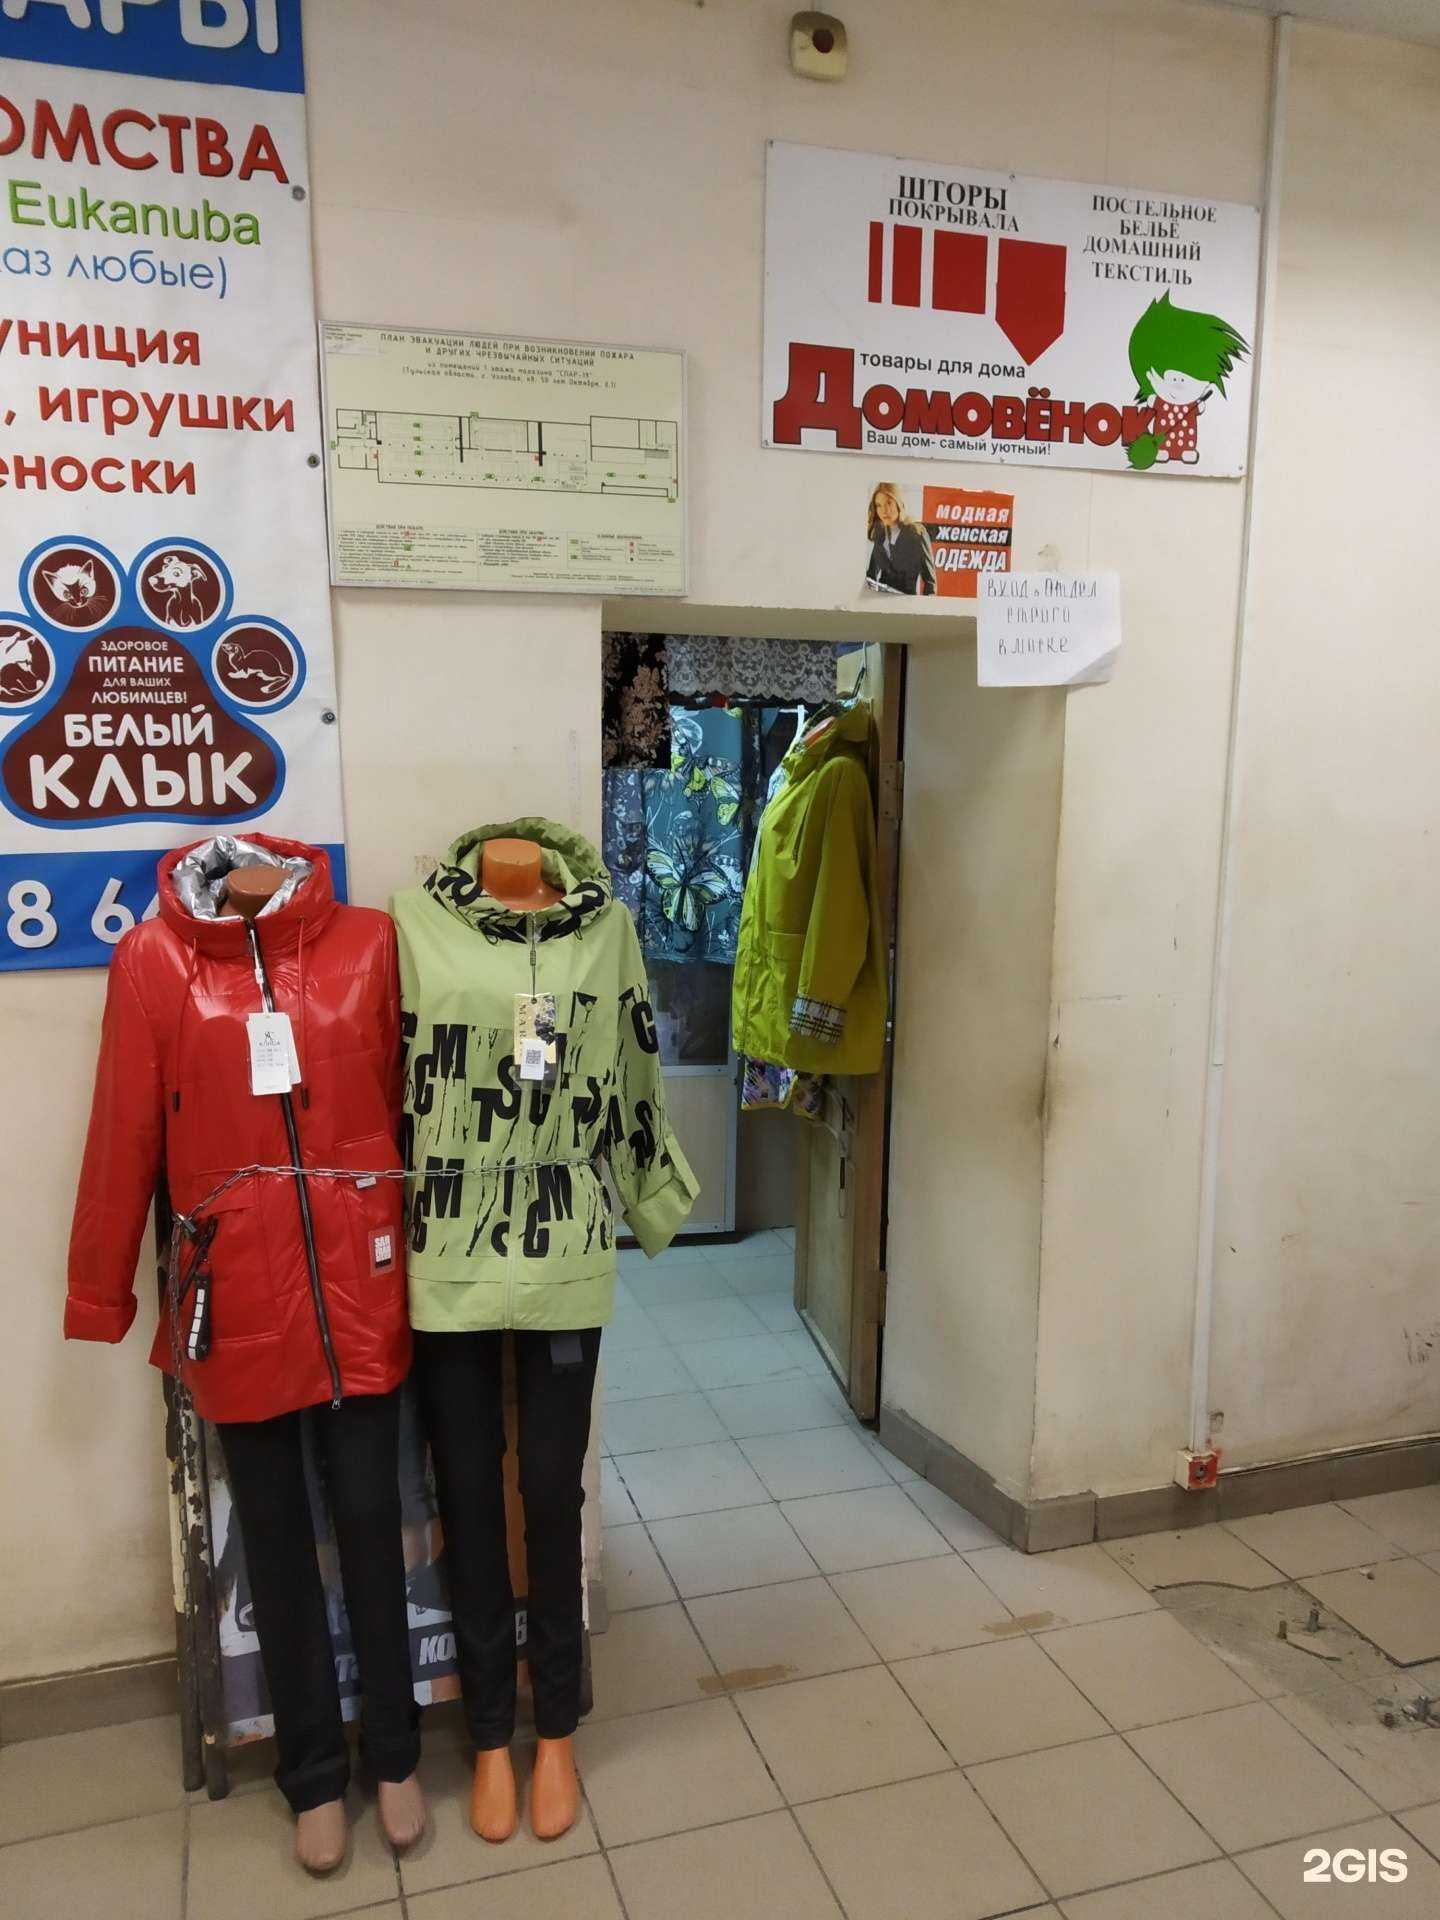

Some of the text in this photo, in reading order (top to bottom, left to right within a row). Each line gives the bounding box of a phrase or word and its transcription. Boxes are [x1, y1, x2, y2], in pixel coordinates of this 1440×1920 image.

[898, 175, 1009, 211] ШТОРЫ
[8, 179, 261, 246] Eukanuba
[889, 198, 1020, 233] ПОКРЫВАЛА
[1092, 194, 1218, 223] ПОСТЕЛЬНОЕ
[1119, 217, 1180, 239] БЕЛЬЁ
[1082, 235, 1201, 261] ДОМАШНИЙ
[0, 246, 228, 299] аз любые)
[1091, 261, 1193, 286] ТЕКСТИЛЬ
[380, 333, 406, 343] ПЛАН
[410, 335, 464, 348] ЭВАКУАЦИИ
[470, 340, 499, 350] ЛЮДЕЙ
[503, 342, 521, 351] ПРИ
[600, 350, 636, 361] ПОЖАРА
[436, 347, 471, 358] ДРУГИХ
[860, 352, 1026, 379] товары для дома
[39, 386, 295, 437] игрушки
[866, 430, 1051, 456] Ваш дом- самый уютный!
[935, 526, 1009, 544] женская
[934, 547, 1006, 572] ОДЕЖДА
[987, 578, 1029, 599] ВХОД
[100, 640, 168, 651] ЗДОРОВОЕ
[88, 656, 185, 673] ПИТАНИЕ
[102, 677, 172, 688] ДЛЯ ВАШИХ
[91, 691, 188, 705] ЛЮБИМЦЕВ!
[63, 703, 214, 747] БЕЛЫЙ
[29, 751, 257, 810] КЛЫК
